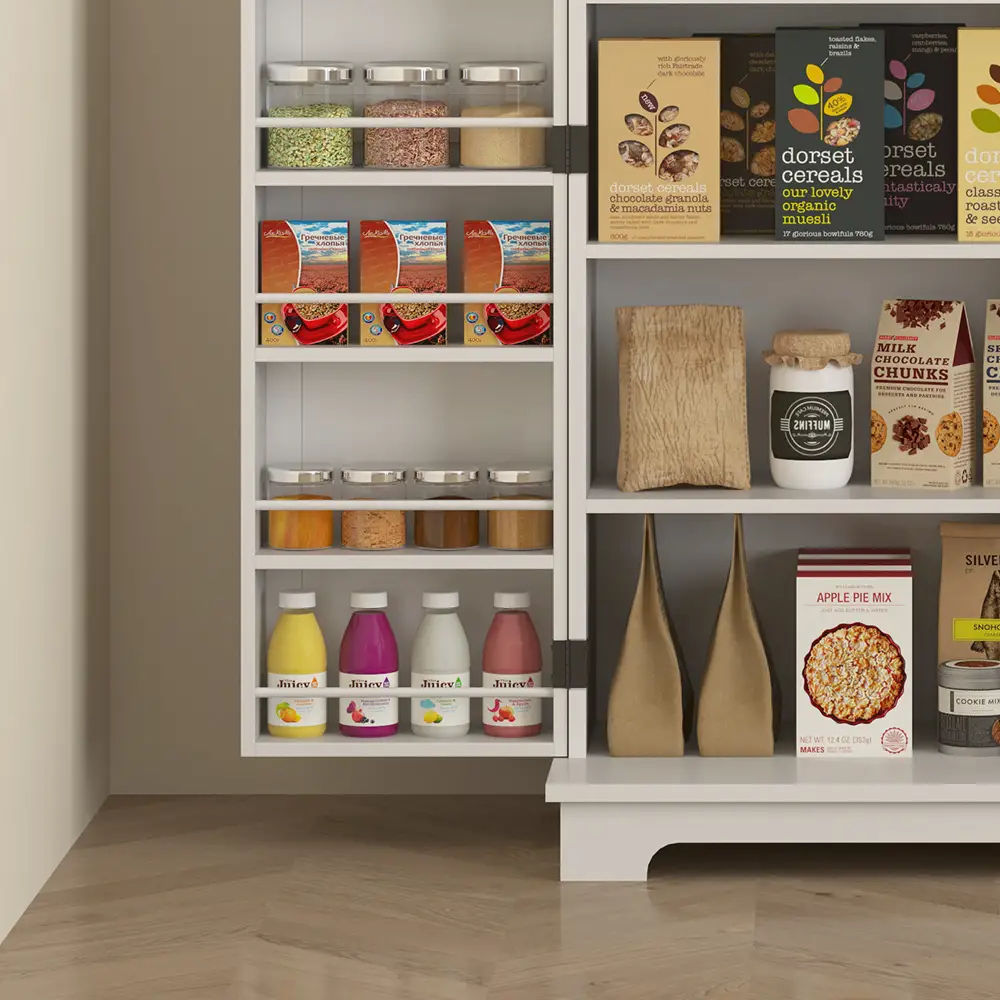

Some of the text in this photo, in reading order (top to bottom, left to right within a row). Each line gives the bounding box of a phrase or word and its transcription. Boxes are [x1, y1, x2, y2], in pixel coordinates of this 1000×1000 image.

[640, 93, 656, 111] new
[781, 147, 855, 164] dorset
[884, 142, 937, 159] orset
[781, 166, 864, 183] cereals
[720, 176, 746, 187] rset
[609, 182, 707, 193] dorset cereals
[782, 186, 854, 200] our lovely
[609, 193, 709, 204] chocolate granola
[609, 203, 712, 213] & macadamia nuts
[782, 200, 837, 213] organic
[782, 213, 832, 225] muesli
[965, 213, 978, 224] &
[792, 230, 822, 238] glorious
[877, 343, 917, 353] MILK
[875, 355, 950, 366] CHOCOLATE
[873, 366, 949, 380] CHUNKS
[816, 592, 892, 603] APPLE PIE MIX
